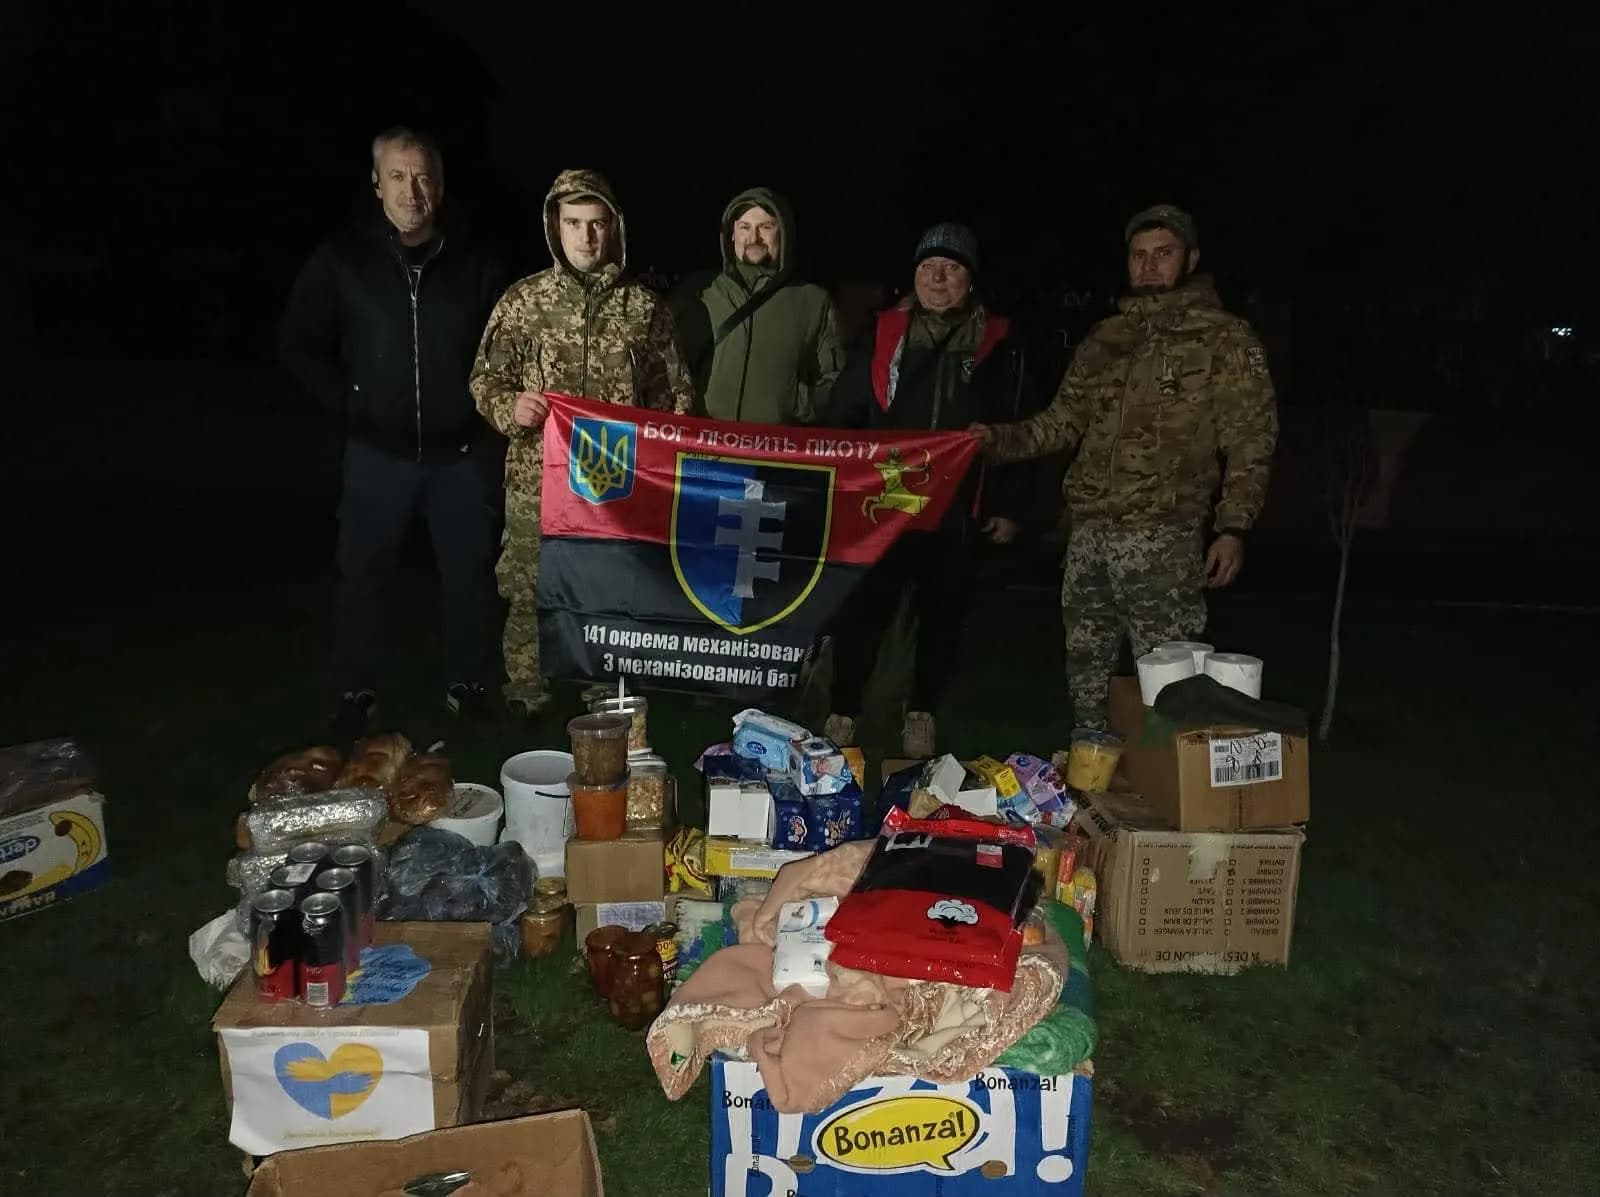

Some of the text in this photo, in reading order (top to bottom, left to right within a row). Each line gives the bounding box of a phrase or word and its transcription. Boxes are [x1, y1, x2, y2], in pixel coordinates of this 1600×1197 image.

[643, 422, 690, 442] БОГ
[583, 624, 606, 645] 141
[609, 630, 679, 651] окрема
[603, 653, 614, 672] 3
[618, 657, 763, 687] механізований
[974, 1072, 1057, 1093] Bonanza!
[833, 1109, 966, 1157] Bonanza!
